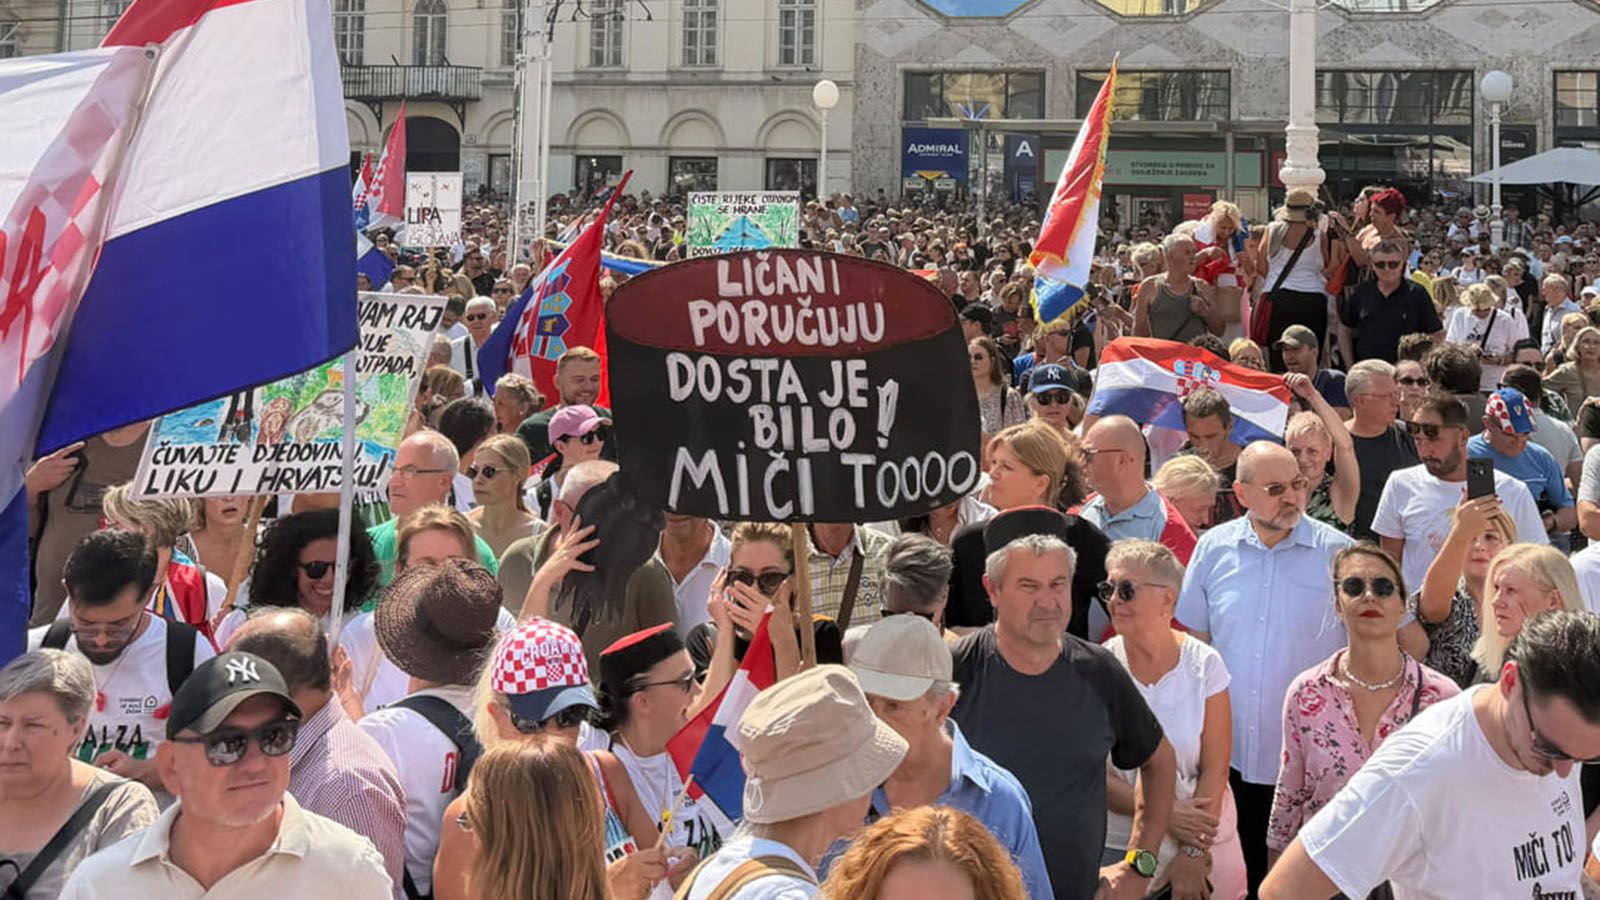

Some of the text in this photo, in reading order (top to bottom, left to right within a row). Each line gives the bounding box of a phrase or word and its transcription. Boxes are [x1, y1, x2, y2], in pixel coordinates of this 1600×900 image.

[907, 143, 963, 154] ADMIRAL
[1015, 140, 1034, 158] A
[718, 205, 728, 214] SE
[722, 194, 757, 204] RIJEKE
[407, 207, 442, 225] LIPA
[717, 252, 840, 298] LIČANI
[399, 305, 443, 331] RAJ
[688, 297, 885, 347] PORUČUJU
[355, 355, 416, 379] OTPADA,
[666, 352, 869, 408] DOSTA JE
[152, 440, 363, 465] ČUVAJTE DJEDOVIN,
[143, 468, 218, 495] LIKU
[230, 468, 243, 494] I
